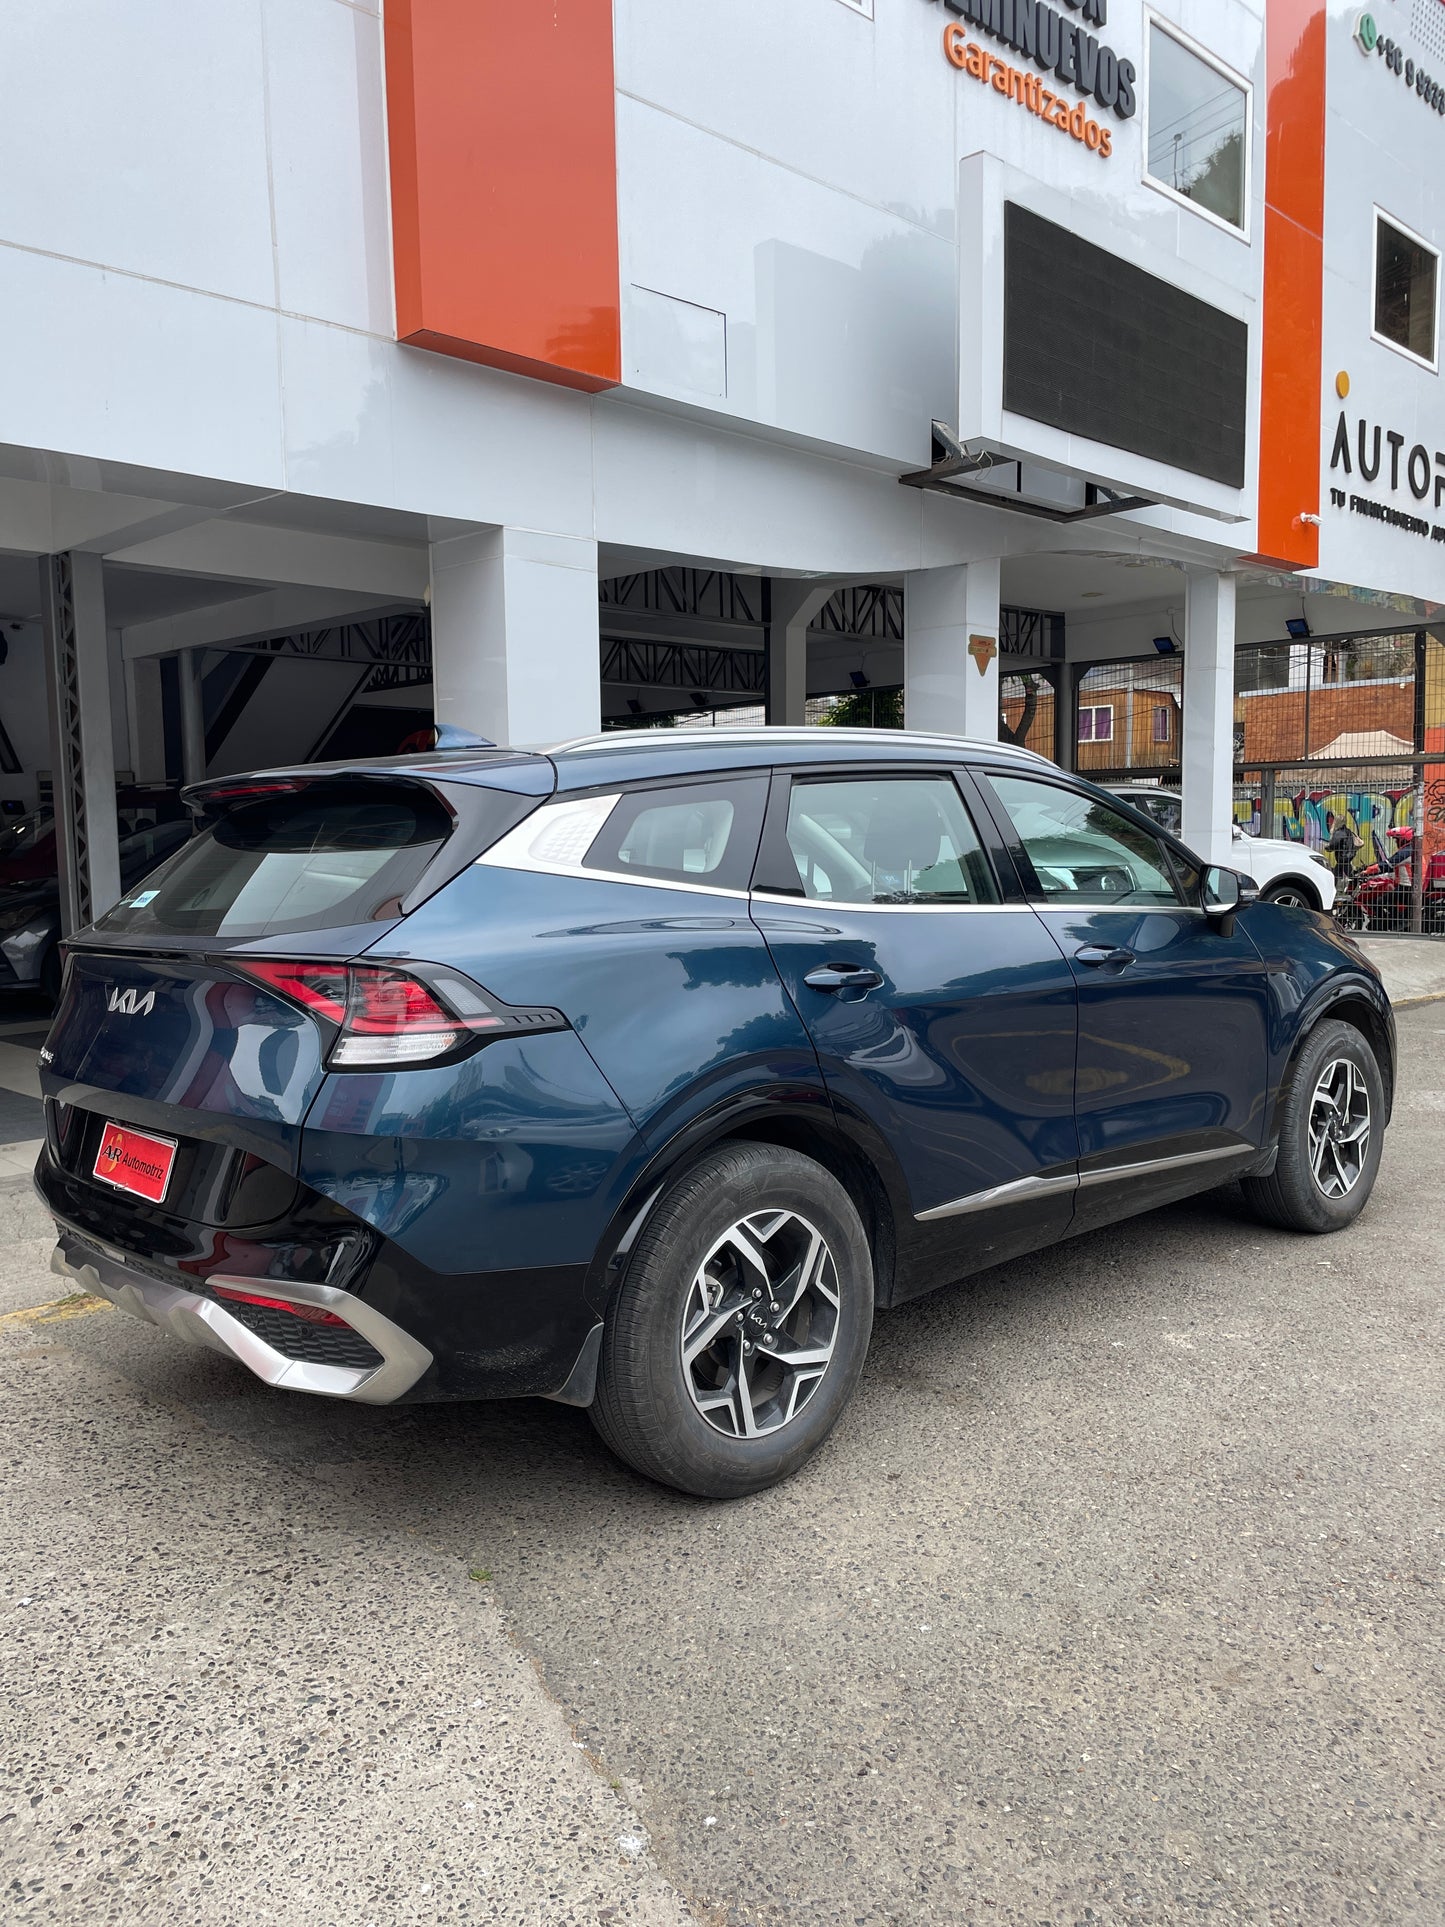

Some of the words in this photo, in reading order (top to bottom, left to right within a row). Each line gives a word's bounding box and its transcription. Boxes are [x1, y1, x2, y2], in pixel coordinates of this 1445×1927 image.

[943, 22, 1113, 158] Garantizados
[1330, 487, 1346, 508] TU
[121, 1152, 164, 1180] Automotriz
